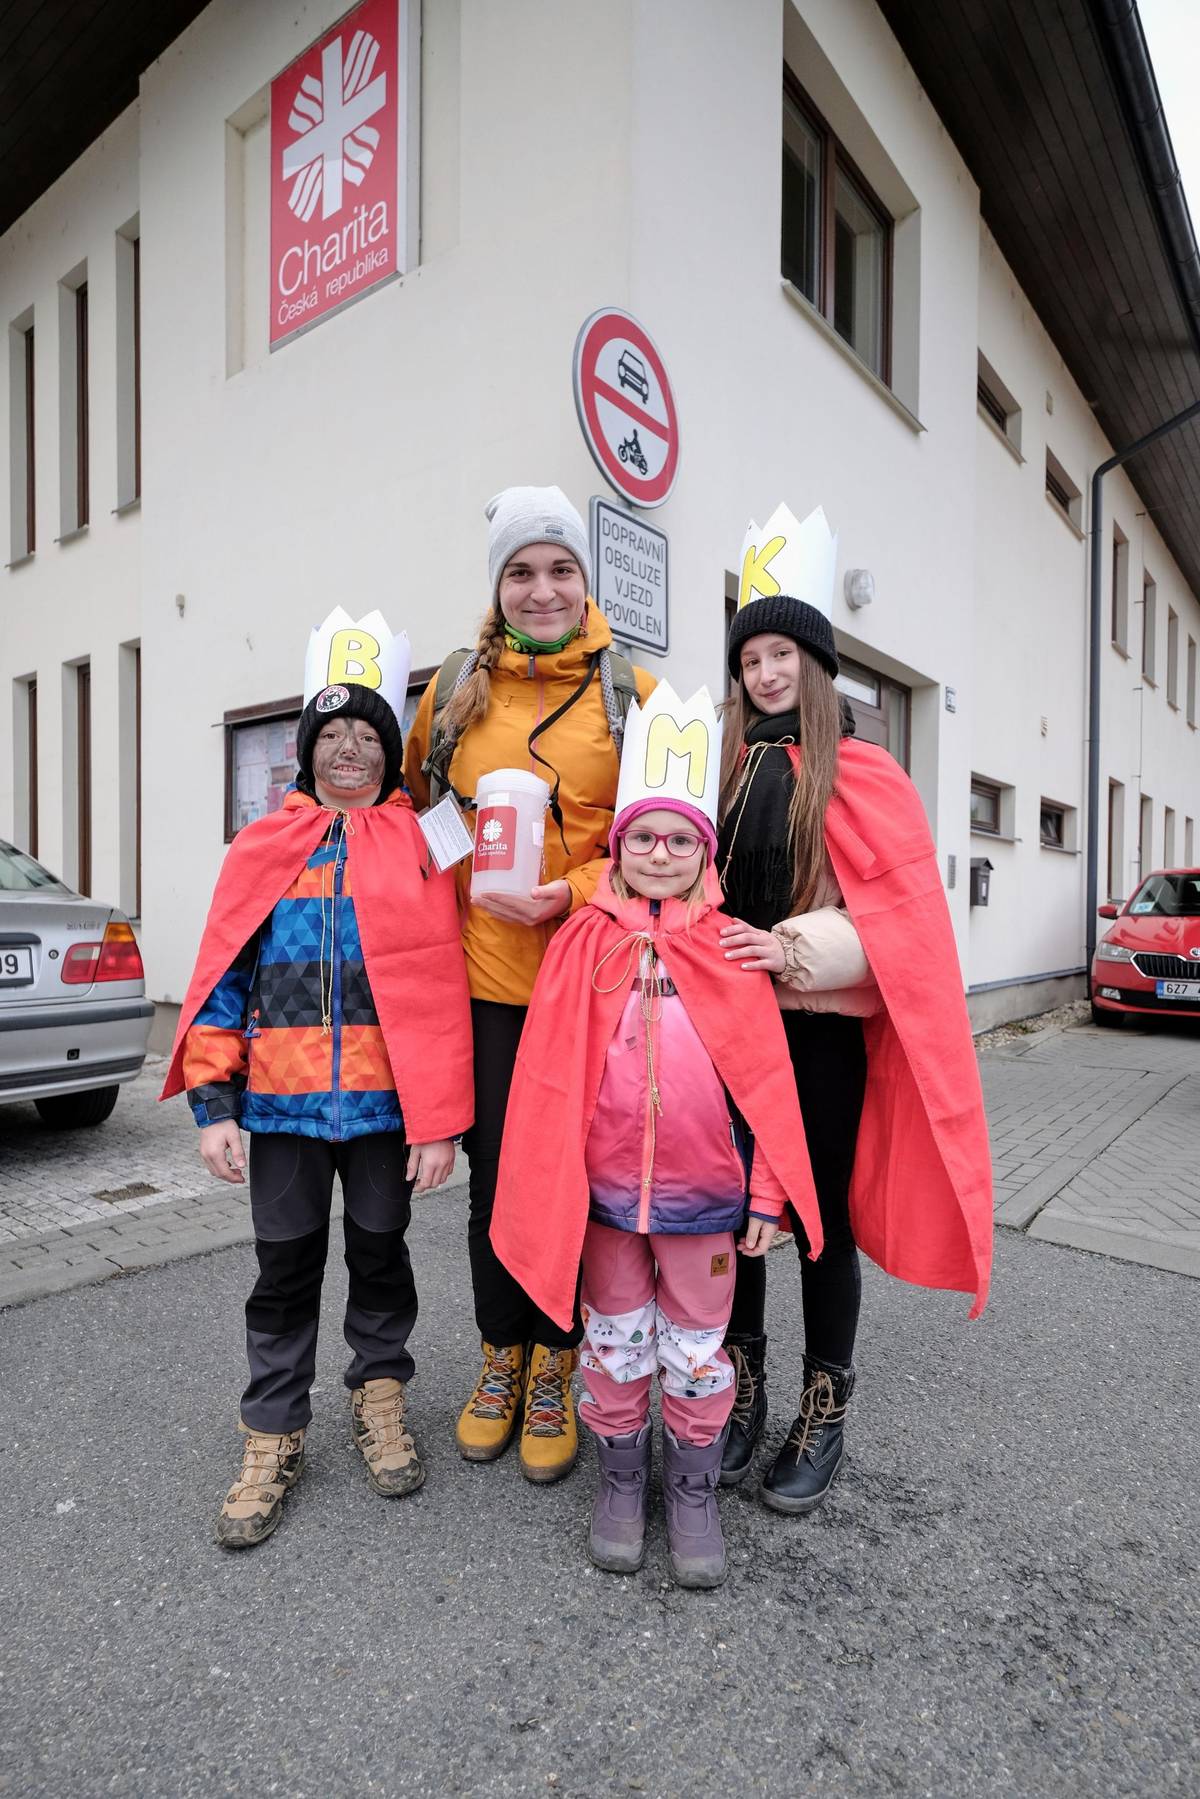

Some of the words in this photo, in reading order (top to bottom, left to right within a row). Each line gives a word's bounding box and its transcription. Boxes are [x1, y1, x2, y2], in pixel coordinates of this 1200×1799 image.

[278, 200, 389, 296] Charita
[278, 286, 319, 325] Česká
[325, 247, 389, 298] republika
[602, 517, 664, 564] DOPRAVNÍ
[604, 546, 662, 587] OBSLUZE
[740, 535, 787, 609] K
[614, 575, 654, 608] VJEZD
[604, 599, 662, 637] POVOLEN
[327, 628, 382, 690] B
[645, 713, 709, 798] M
[477, 842, 508, 852] Charita
[0, 953, 18, 975] 9
